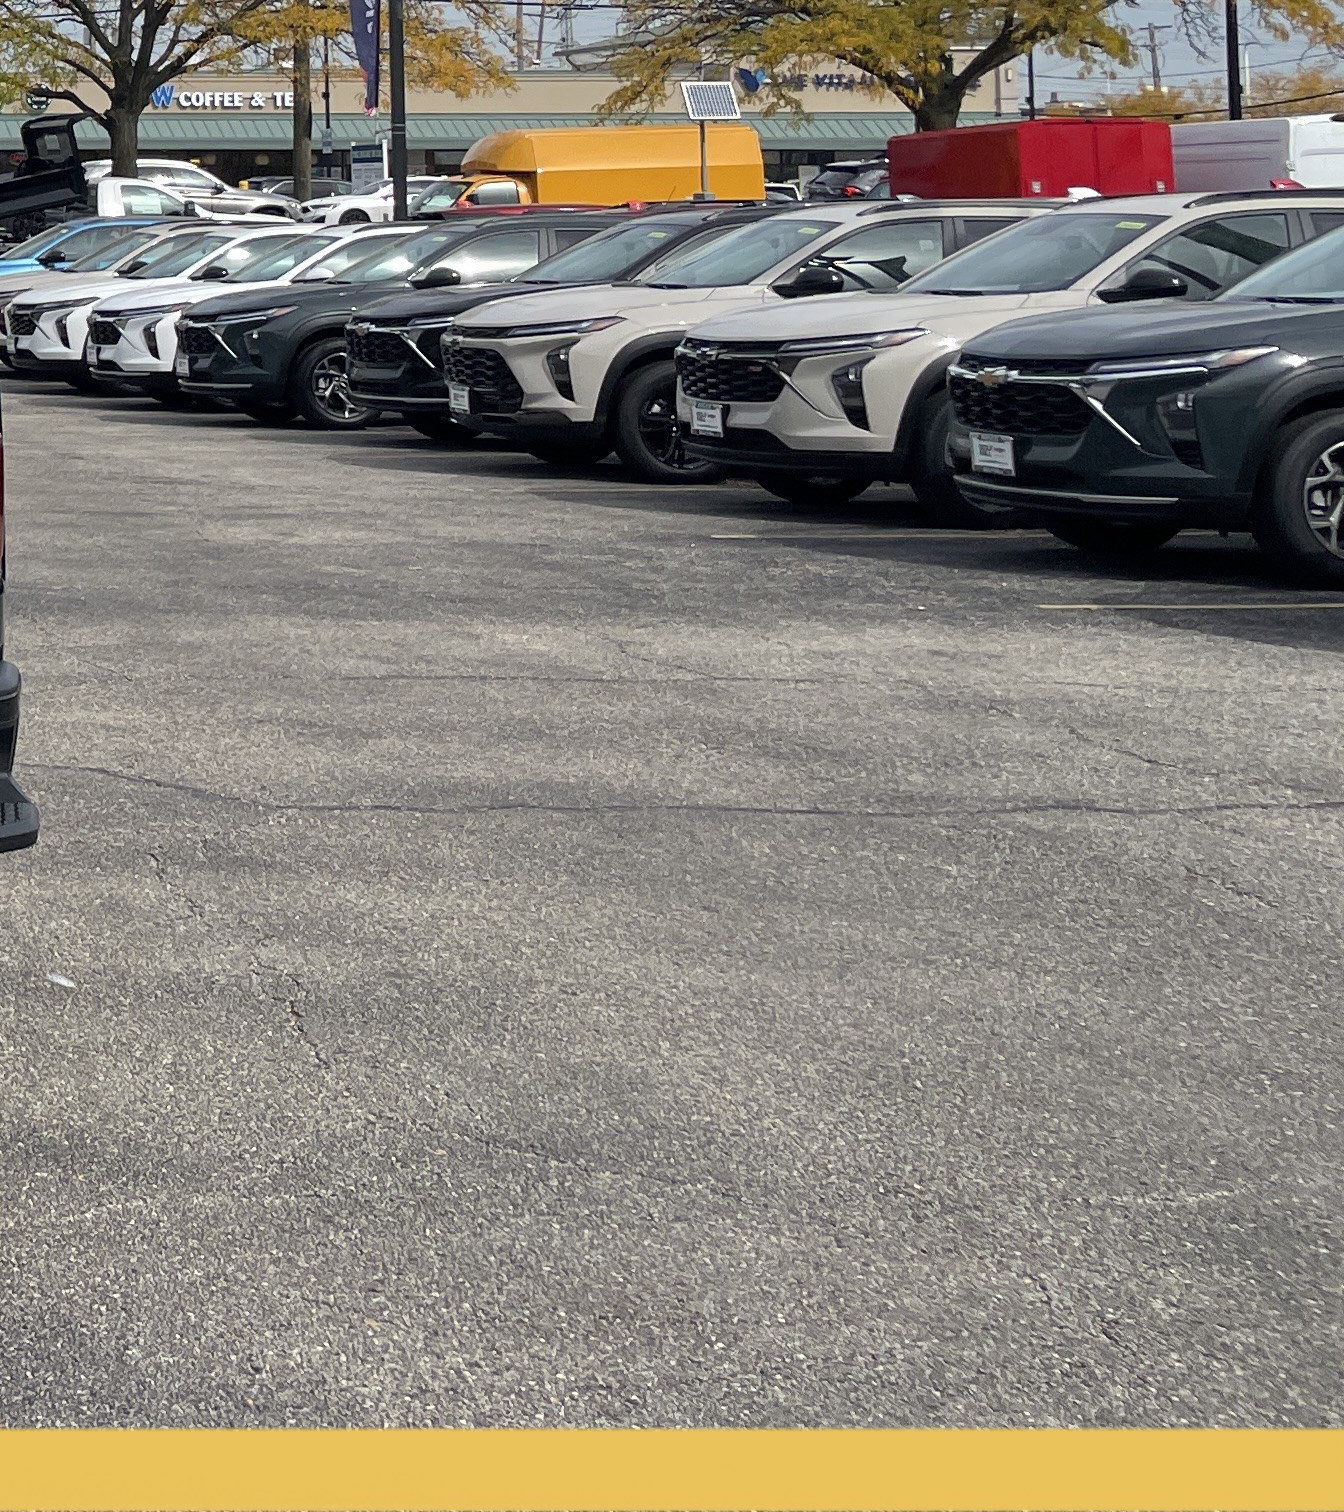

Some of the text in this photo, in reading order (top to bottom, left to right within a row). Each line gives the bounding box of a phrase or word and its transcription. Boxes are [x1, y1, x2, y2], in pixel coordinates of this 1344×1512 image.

[178, 92, 243, 107] COFFEE
[250, 92, 265, 107] &
[273, 92, 294, 107] TE
